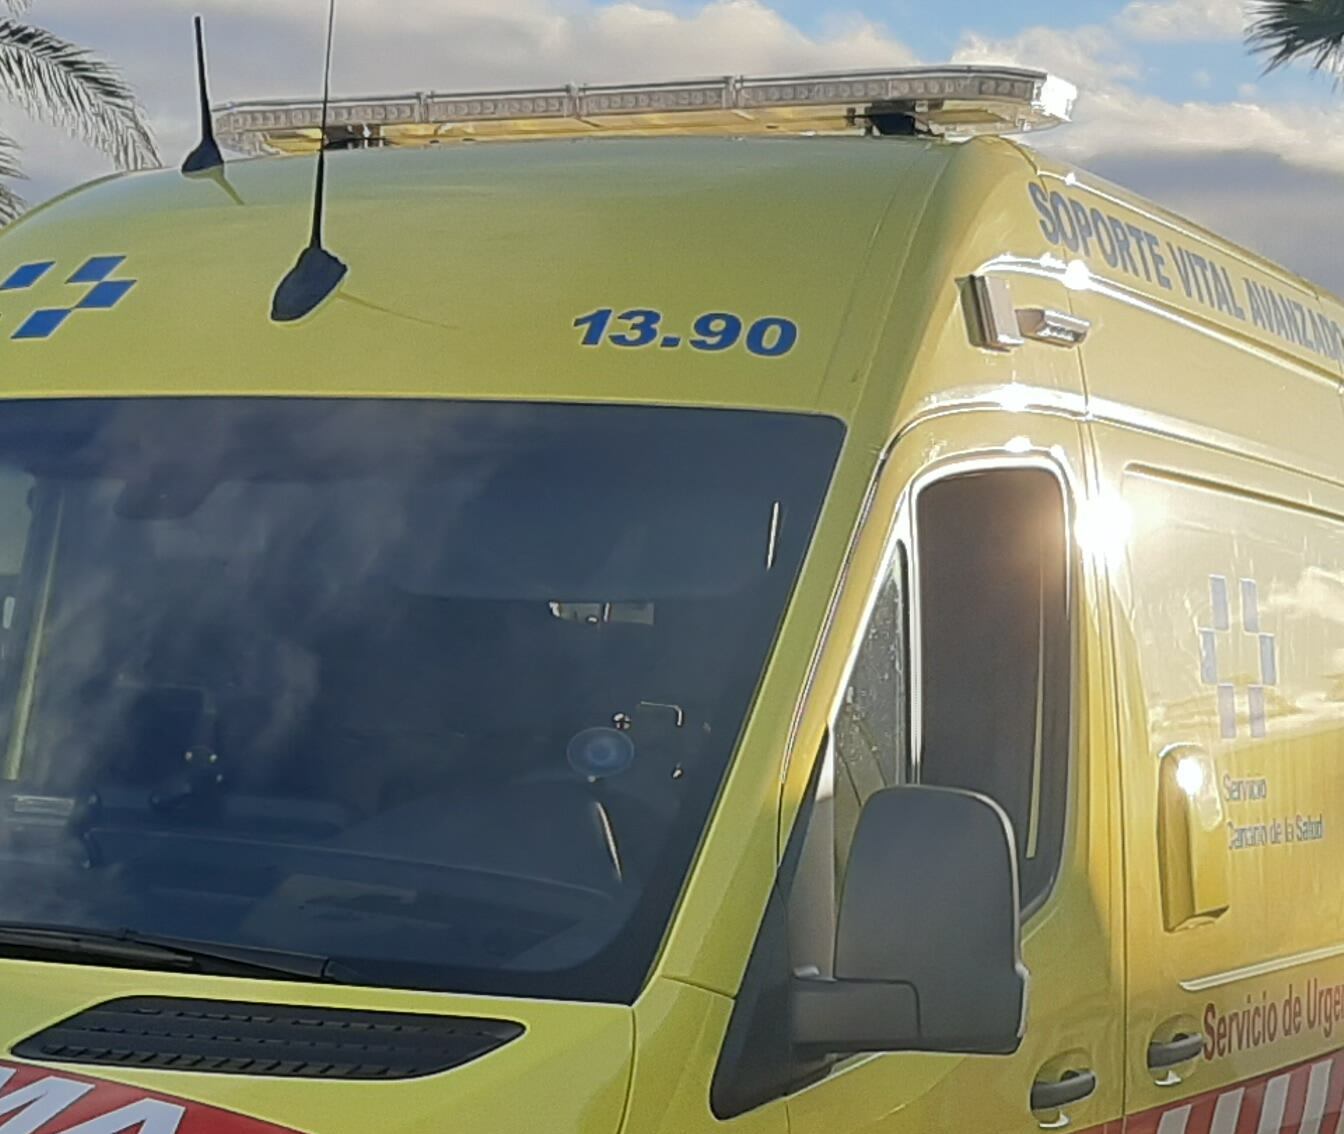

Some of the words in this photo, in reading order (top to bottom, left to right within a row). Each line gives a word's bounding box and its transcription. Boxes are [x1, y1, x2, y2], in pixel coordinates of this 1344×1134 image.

[1028, 181, 1173, 291] SOPORTE
[1166, 240, 1247, 322] VITAL
[570, 308, 799, 359] 13.90
[1223, 773, 1268, 802] Servicio
[1269, 817, 1282, 845] de
[1284, 816, 1295, 843] la
[1295, 812, 1324, 842] Salud
[1203, 990, 1278, 1061] Servicio
[1282, 983, 1302, 1037] de
